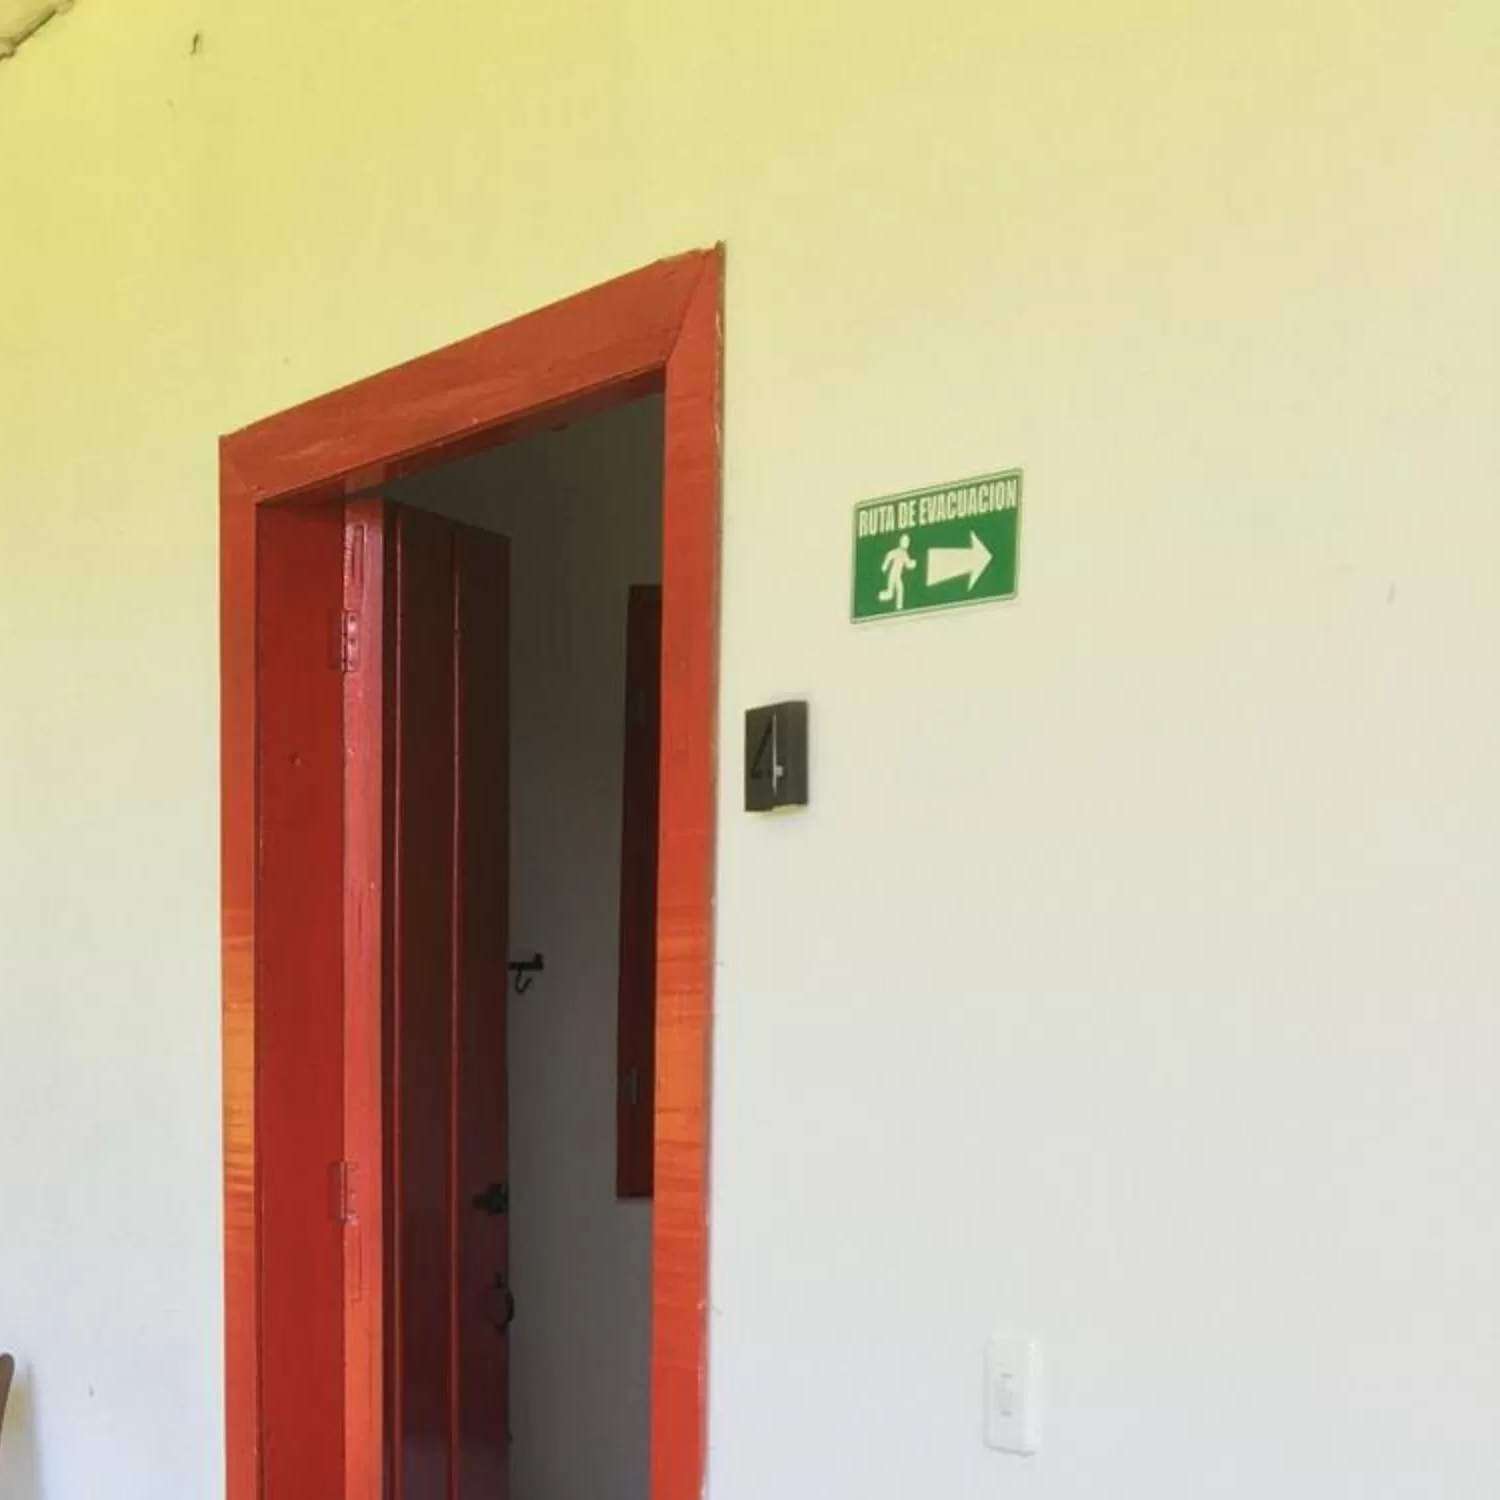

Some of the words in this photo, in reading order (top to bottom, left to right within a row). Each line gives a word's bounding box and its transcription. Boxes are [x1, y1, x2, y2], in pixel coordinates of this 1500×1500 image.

[858, 504, 895, 538] RUTA
[897, 500, 917, 529] DE
[919, 479, 1017, 526] EVACUACION
[751, 711, 784, 796] 4
